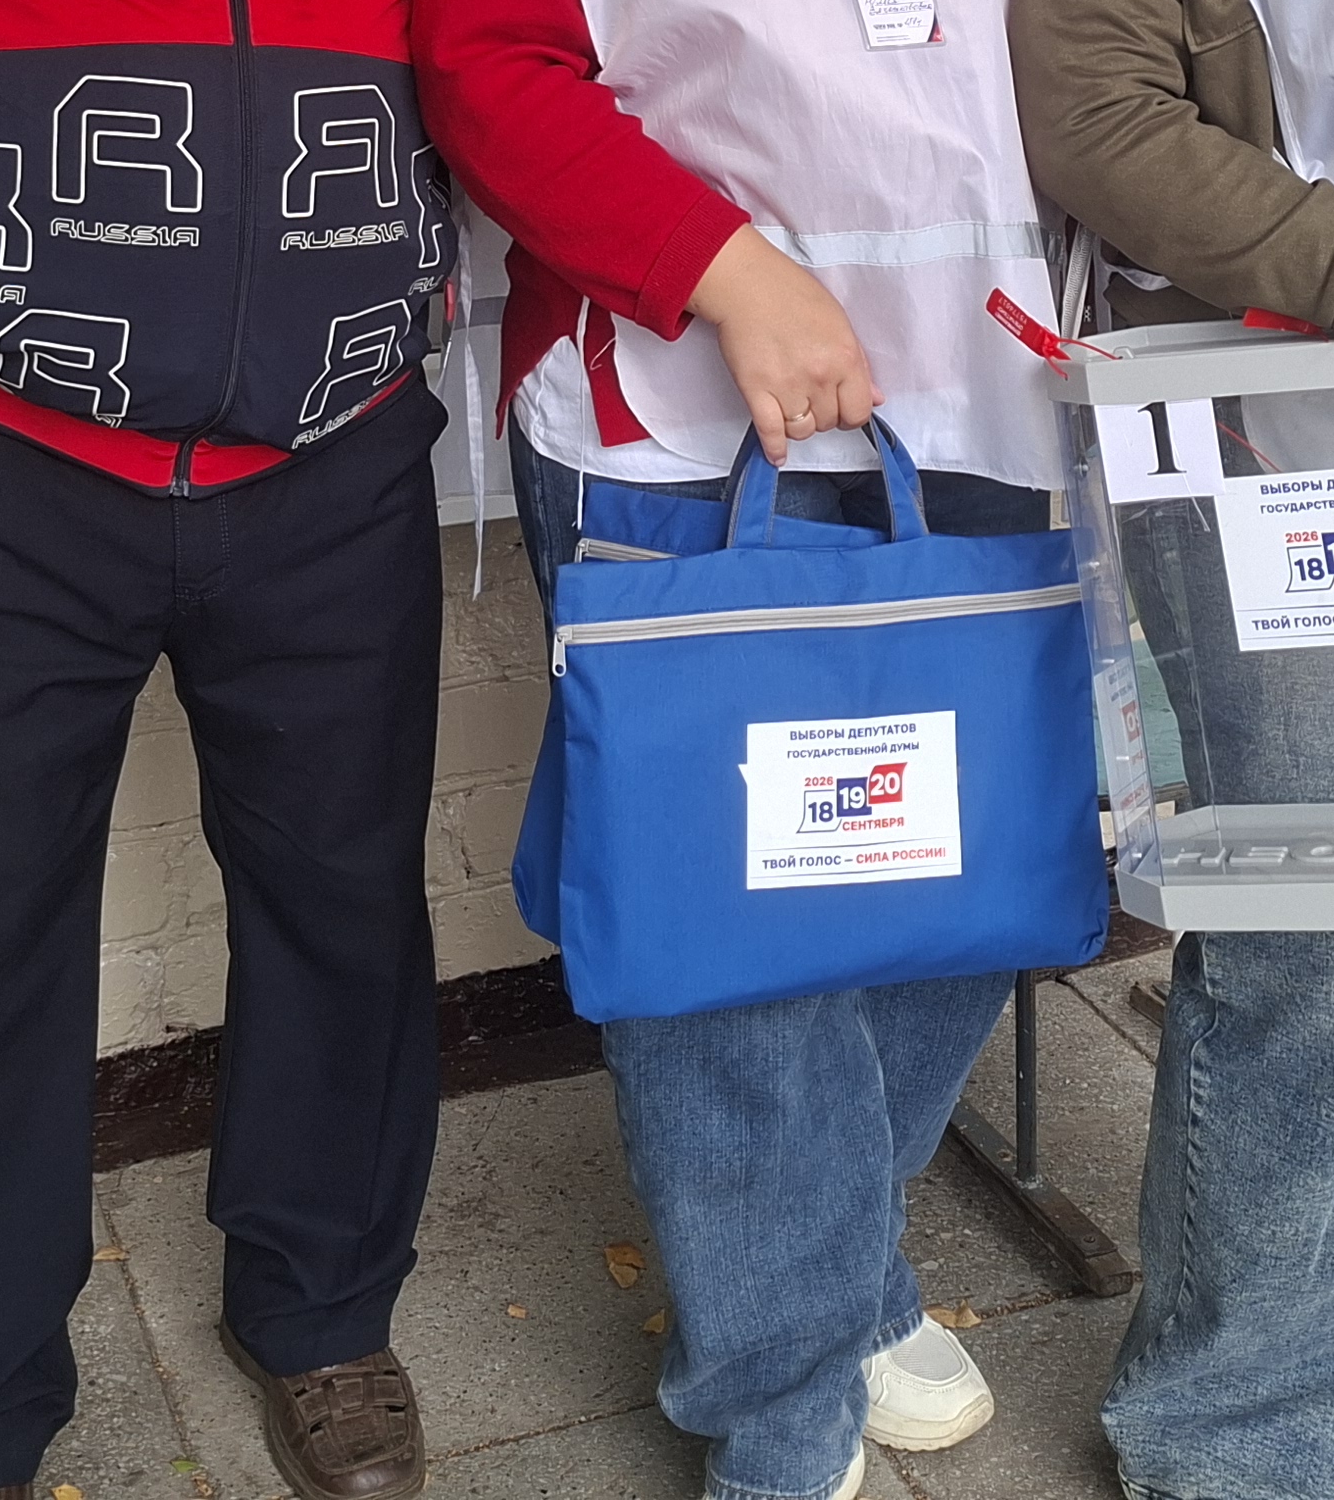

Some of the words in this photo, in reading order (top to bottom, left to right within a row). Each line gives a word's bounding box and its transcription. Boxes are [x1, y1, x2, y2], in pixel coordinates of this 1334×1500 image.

[1137, 401, 1187, 476] 1
[1260, 481, 1323, 496] ВЫБОРЫ
[1285, 531, 1318, 543] 2026
[1294, 558, 1325, 581] 18
[1252, 616, 1291, 631] ТВОЙ
[790, 728, 845, 741] ВЫБОРЫ
[848, 723, 916, 740] ДЕПУТАТОВ
[787, 743, 888, 759] ГОСУДАРСТВЕННОЙ
[890, 741, 919, 753] ДУМЫ
[804, 777, 834, 787] 2026
[808, 802, 834, 823] 18
[839, 786, 865, 810] 19
[870, 772, 900, 796] 20
[842, 817, 904, 831] СЕНТЯБРЯ
[762, 855, 796, 870] ТВОЙ
[799, 856, 842, 868] ГОЛОС
[856, 852, 890, 864] СИЛА
[892, 847, 946, 861] РОССИИ!
